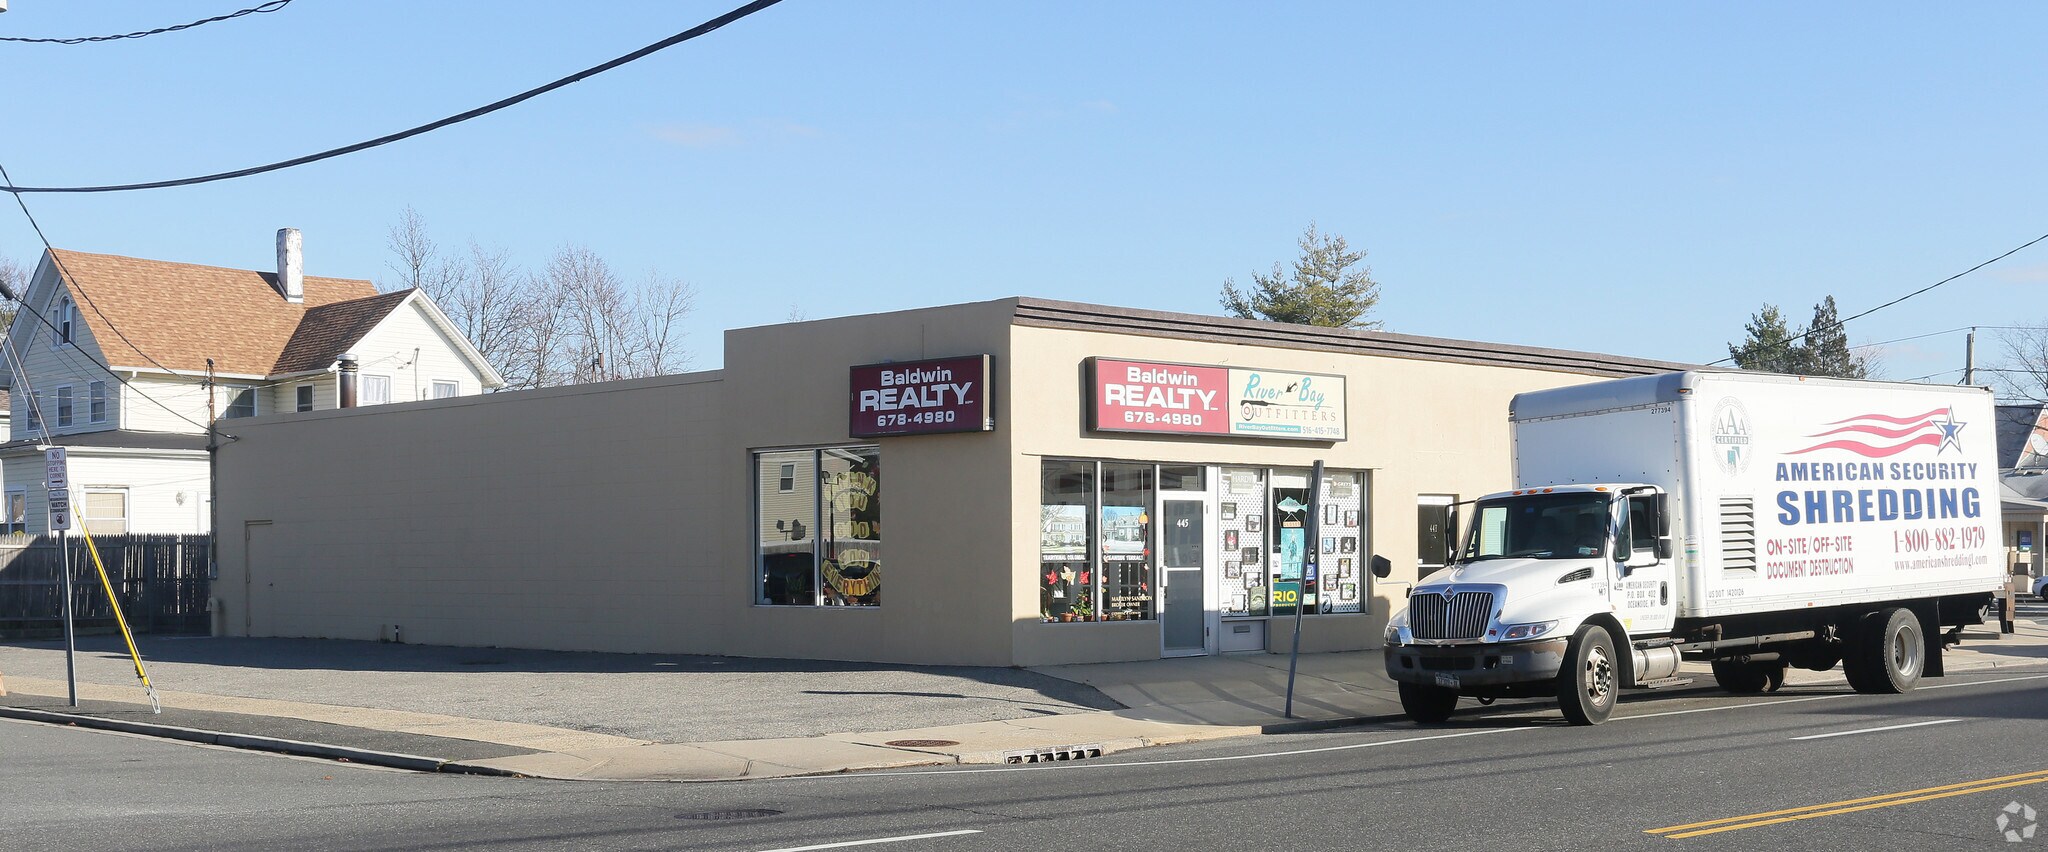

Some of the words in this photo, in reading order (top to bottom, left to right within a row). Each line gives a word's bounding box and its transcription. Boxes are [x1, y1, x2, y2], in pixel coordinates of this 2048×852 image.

[880, 366, 952, 387] Baldwin
[1127, 366, 1198, 386] Baldwin
[859, 381, 973, 412] REALTY
[1105, 383, 1217, 411] REALTY
[1243, 372, 1284, 399] River
[1299, 377, 1325, 411] Bay
[877, 410, 955, 427] 678-4980
[1124, 411, 1202, 426] 678-4980
[1243, 406, 1337, 422] OUTFITTERS
[1651, 407, 1671, 415] 277394
[1716, 408, 1747, 435] AAA
[1717, 436, 1747, 444] CERTIFIED
[51, 451, 60, 460] NO
[1775, 462, 1885, 482] AMERICAN
[1890, 462, 1978, 480] SECURITY
[1776, 487, 1981, 526] SHREDDING
[1176, 518, 1189, 528] 445
[1766, 536, 1853, 556] ON-SITE/OFF-SITE
[1893, 525, 1986, 553] 1-800-882-1979
[1767, 559, 1807, 580] DOCUMENT
[1809, 557, 1854, 577] DESTRUCTION
